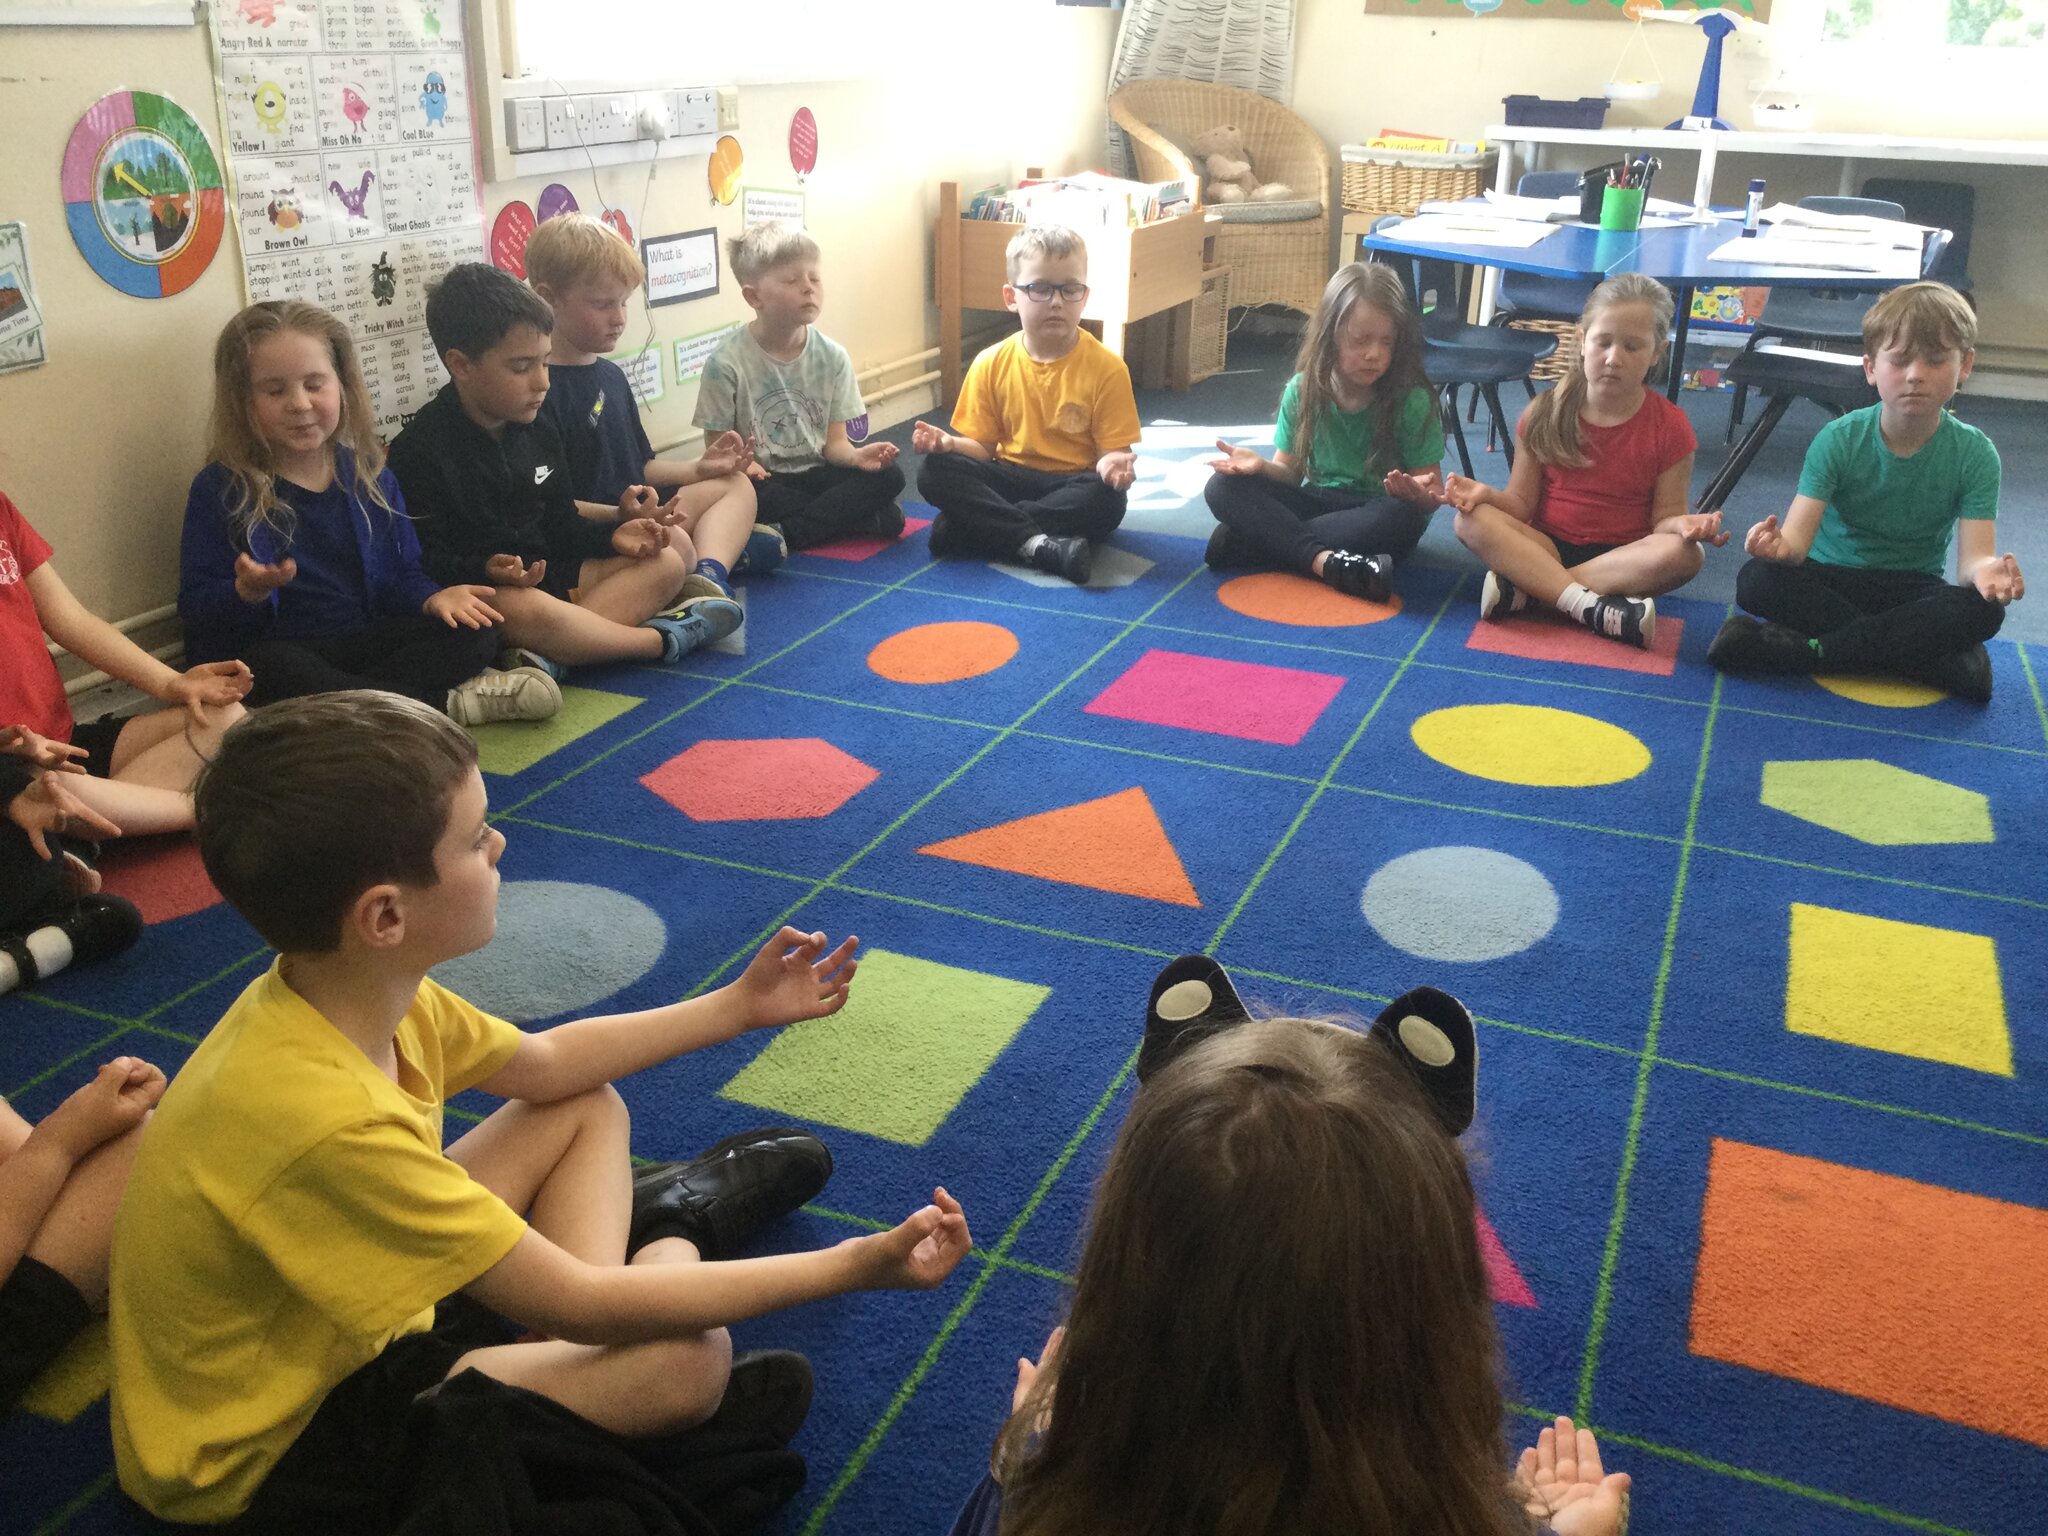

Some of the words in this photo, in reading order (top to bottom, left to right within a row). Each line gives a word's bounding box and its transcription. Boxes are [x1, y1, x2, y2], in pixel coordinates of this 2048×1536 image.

[221, 37, 245, 51] Angry
[247, 36, 263, 47] Red
[265, 36, 272, 48] A
[321, 136, 338, 148] Miss
[339, 134, 351, 146] Oh
[351, 132, 363, 145] No
[402, 129, 418, 142] Cool
[232, 140, 260, 153] Yellow
[243, 171, 270, 182] around
[240, 190, 265, 200] round
[239, 207, 266, 221] found
[510, 209, 522, 225] What
[248, 227, 262, 236] our
[388, 221, 407, 233] Silent
[408, 218, 431, 231] Ghosts
[264, 238, 291, 251] Brown
[292, 234, 309, 248] Owl
[498, 240, 510, 255] What
[510, 254, 522, 270] comes
[649, 247, 674, 264] What
[675, 246, 683, 260] is
[650, 262, 713, 288] metacognition?
[12, 314, 29, 326] Time
[363, 321, 385, 335] Tricky
[385, 316, 405, 330] Witch
[390, 337, 405, 349] eggs
[687, 340, 699, 351] about
[361, 355, 377, 367] gran
[422, 352, 436, 363] best
[393, 361, 406, 372] long
[424, 363, 439, 374] must
[393, 372, 411, 383] along
[426, 376, 438, 389] fish
[395, 383, 416, 395] across
[396, 395, 410, 406] still
[384, 414, 400, 425] Cats
